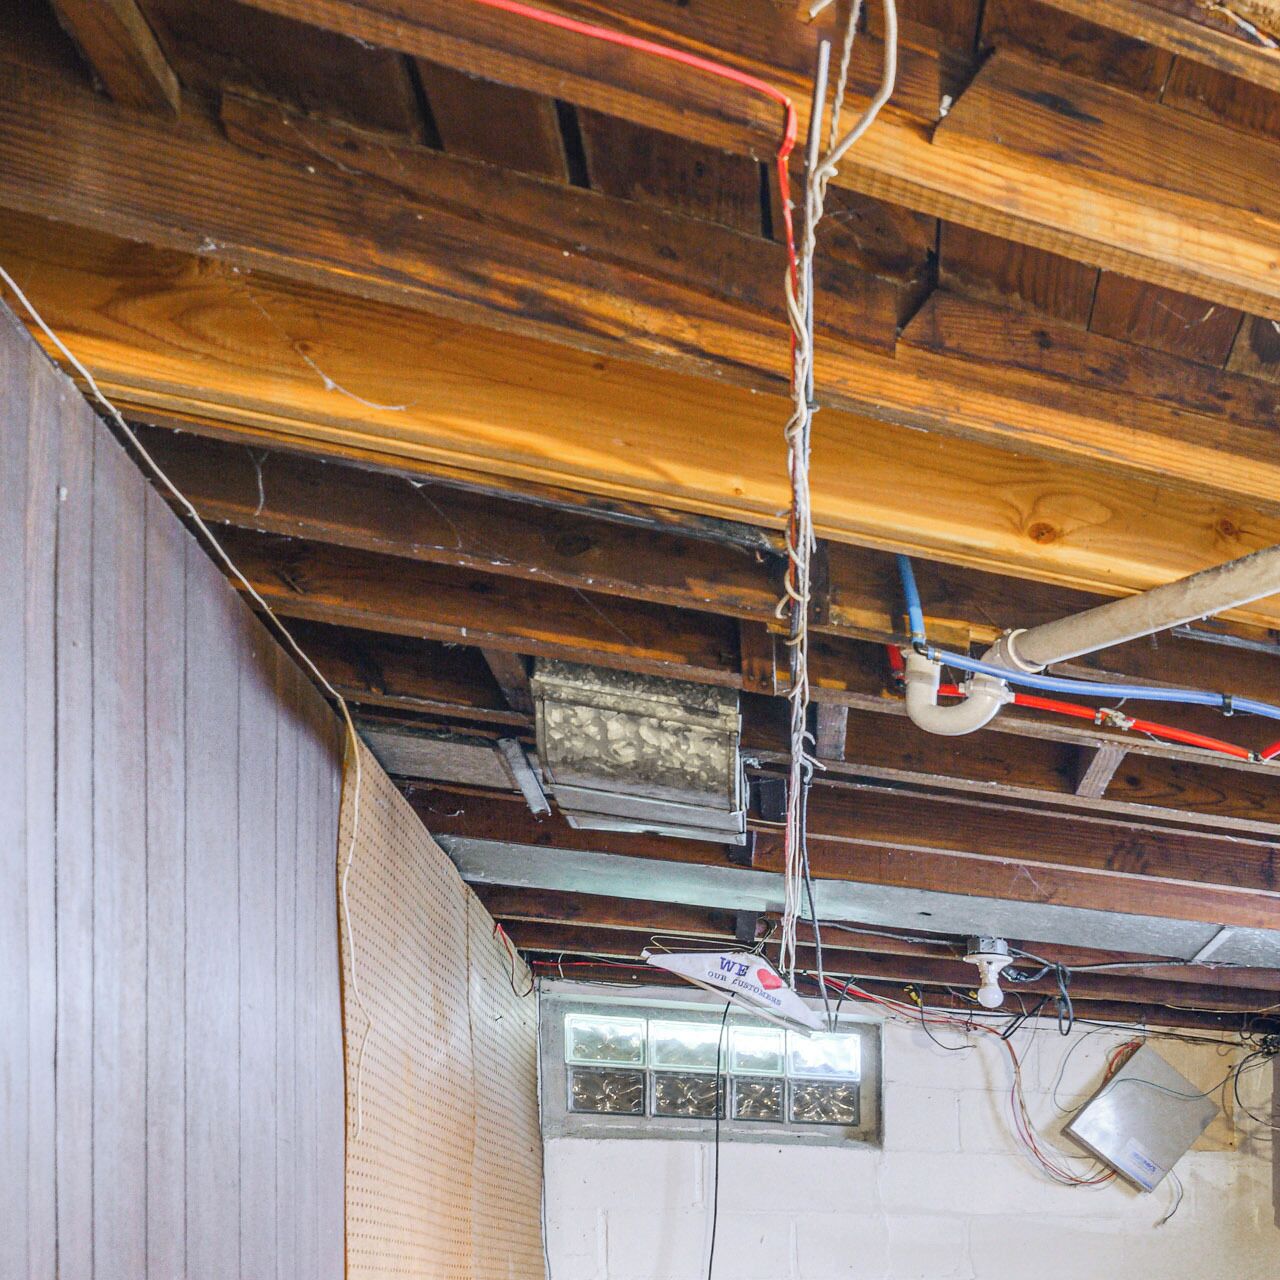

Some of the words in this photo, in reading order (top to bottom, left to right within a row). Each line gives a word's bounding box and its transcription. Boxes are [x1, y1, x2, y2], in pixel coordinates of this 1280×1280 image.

[720, 957, 750, 977] WE
[707, 971, 727, 982] OUR
[731, 978, 782, 1006] CUSTOMERS
